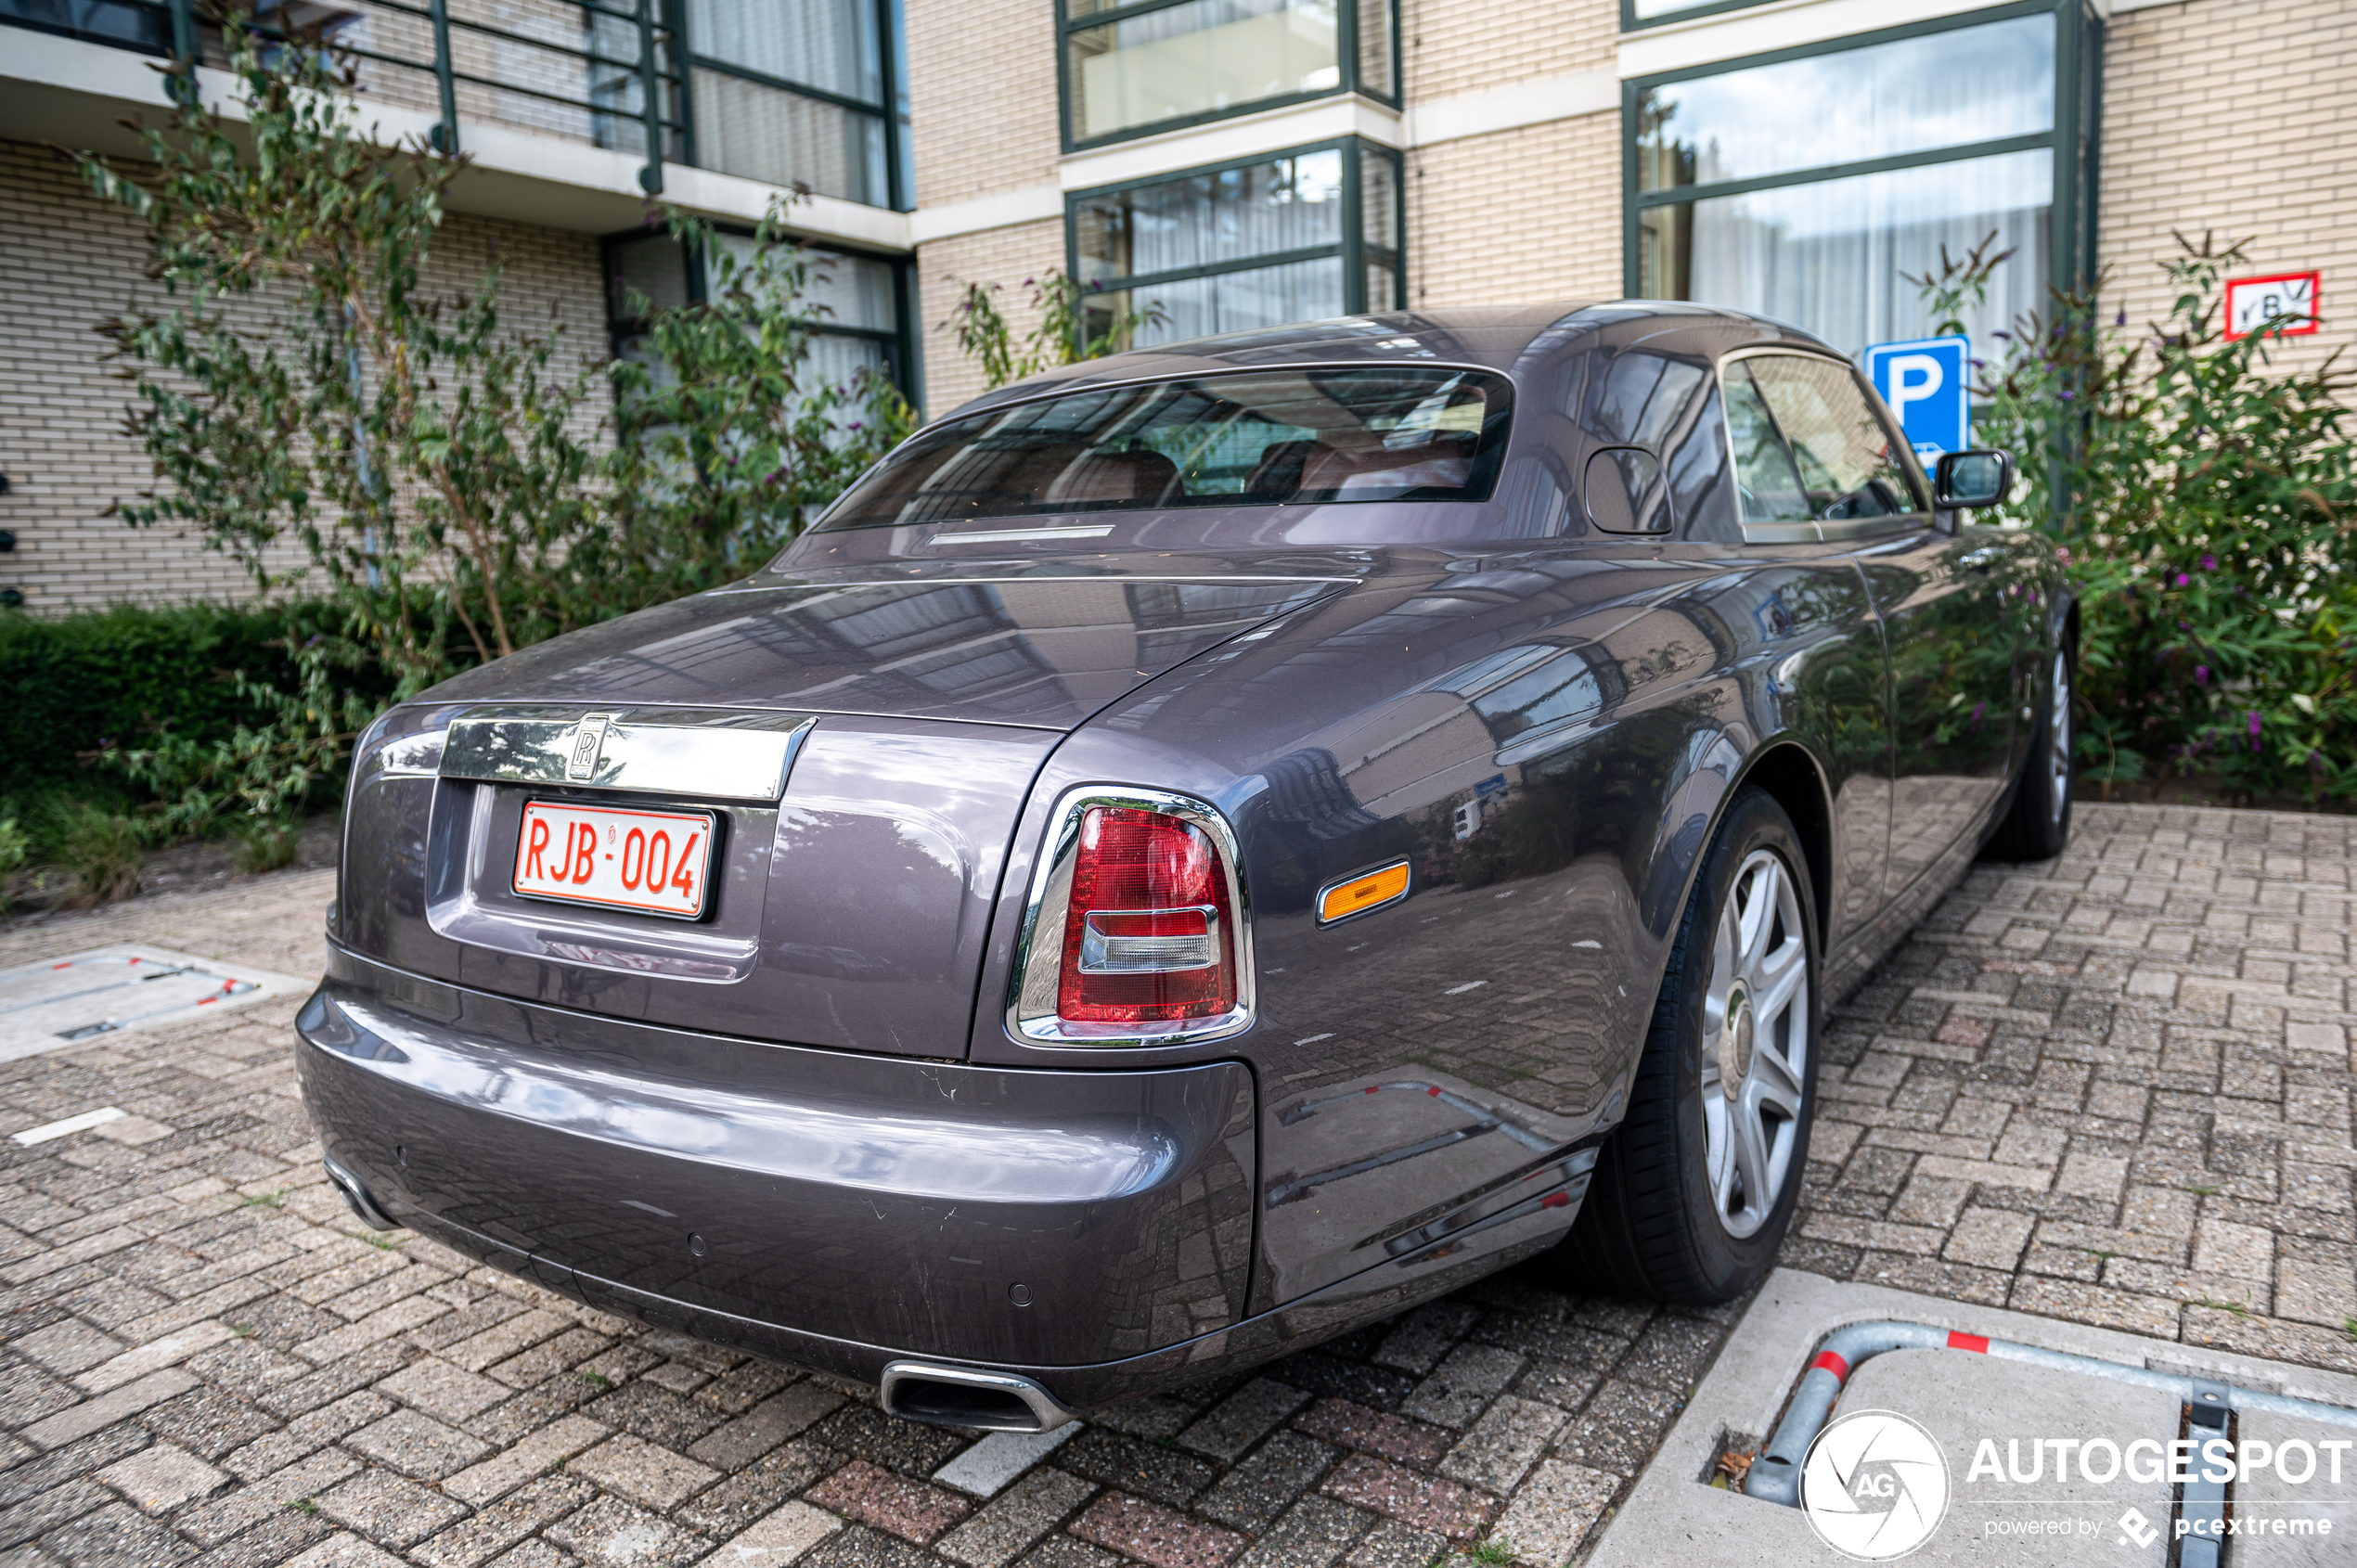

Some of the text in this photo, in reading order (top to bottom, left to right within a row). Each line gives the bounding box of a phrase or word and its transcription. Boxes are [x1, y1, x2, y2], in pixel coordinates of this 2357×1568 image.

[2263, 295, 2280, 319] B
[1888, 353, 1944, 427] P
[524, 817, 700, 898] RJB-004
